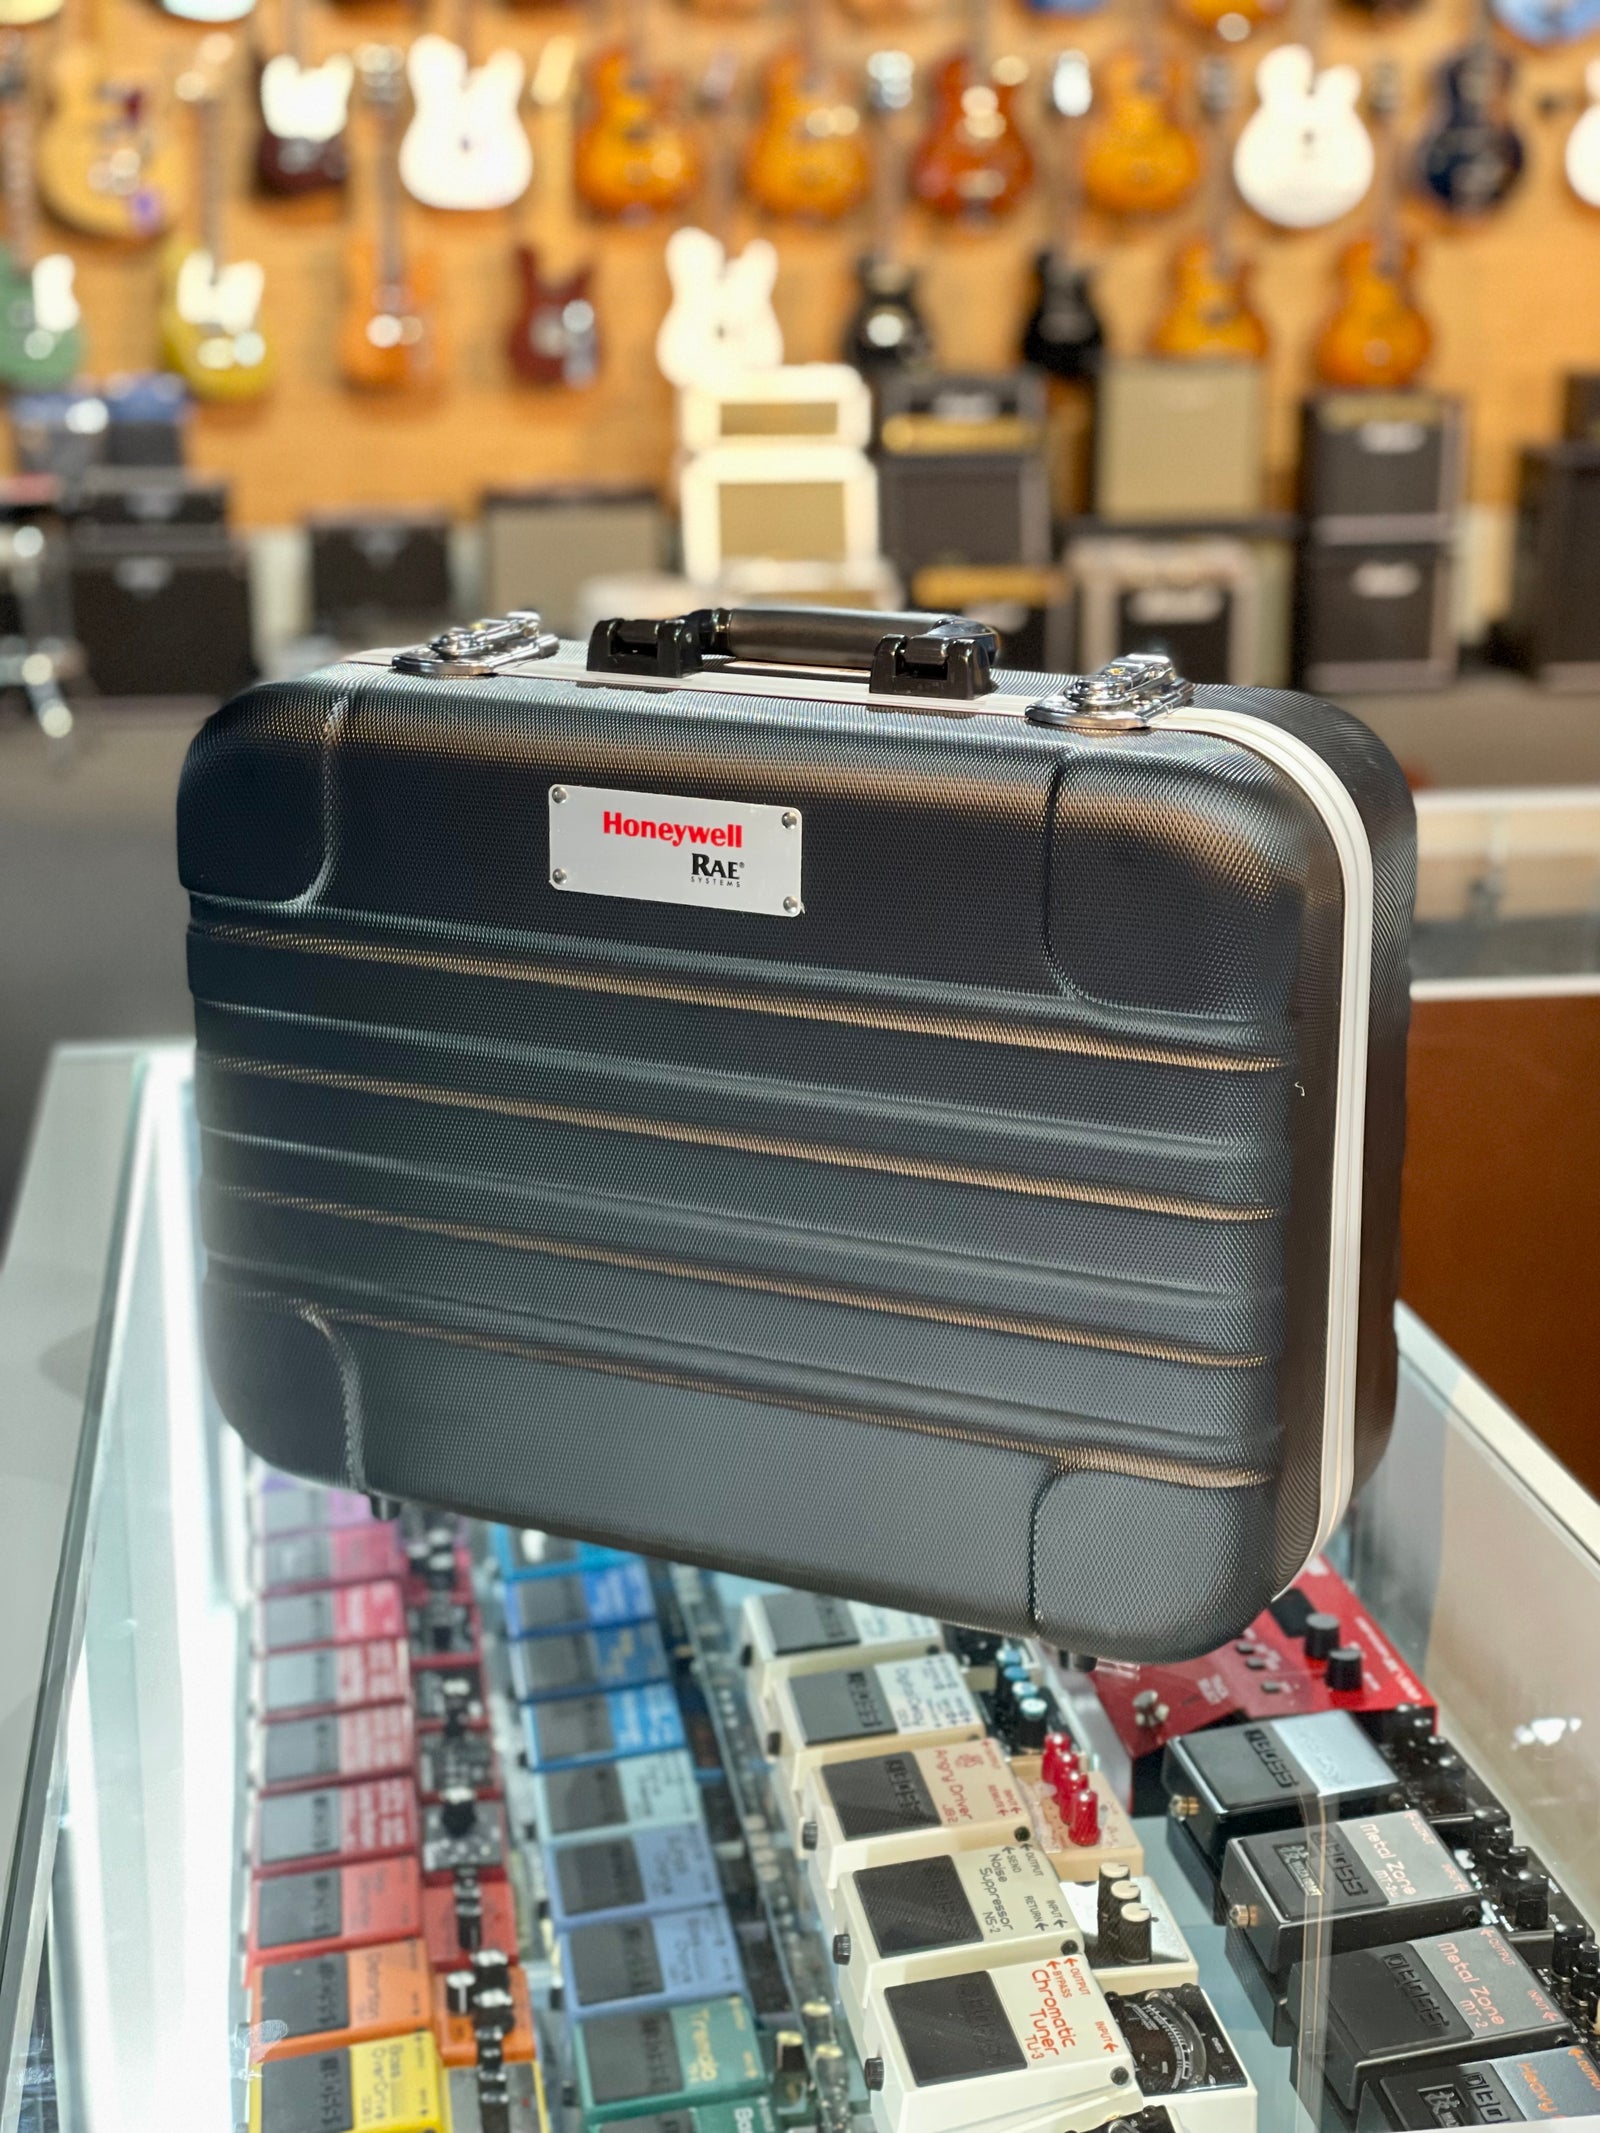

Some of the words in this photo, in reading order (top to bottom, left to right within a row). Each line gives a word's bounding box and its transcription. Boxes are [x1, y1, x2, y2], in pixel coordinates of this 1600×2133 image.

[603, 811, 743, 848] Honeywell
[690, 876, 741, 888] SYSTEMS
[1246, 1733, 1300, 1788] BOSS
[935, 1748, 956, 1782] Angry
[949, 1784, 973, 1820] Driver
[988, 1853, 1007, 1882] Noise
[1007, 1855, 1022, 1873] SEND
[1026, 1852, 1044, 1877] OUTPUT
[1359, 1823, 1396, 1861] Metal
[1386, 1860, 1417, 1896] Zone
[979, 1867, 1013, 1930] Suppressor
[1024, 1895, 1043, 1922] RETURN
[1046, 1900, 1062, 1918] INPUT
[982, 1911, 1001, 1934] NS-2
[1489, 1937, 1516, 1967] OUTPUT
[1052, 1970, 1073, 1998] BYPASS
[1070, 1967, 1091, 1995] OUTPUT
[1438, 1942, 1480, 1983] Metal
[1469, 1986, 1504, 2025] Zone
[1031, 1969, 1076, 2048] Chromatic
[1396, 1966, 1449, 2028] BOSS
[1527, 1989, 1550, 2010] INPUT
[1459, 1999, 1488, 2028] MT-2
[1029, 2008, 1060, 2056] Tuner
[1095, 2021, 1113, 2042] INPUT
[1024, 2034, 1045, 2060] TU-3
[1517, 2062, 1557, 2112] Heavy
